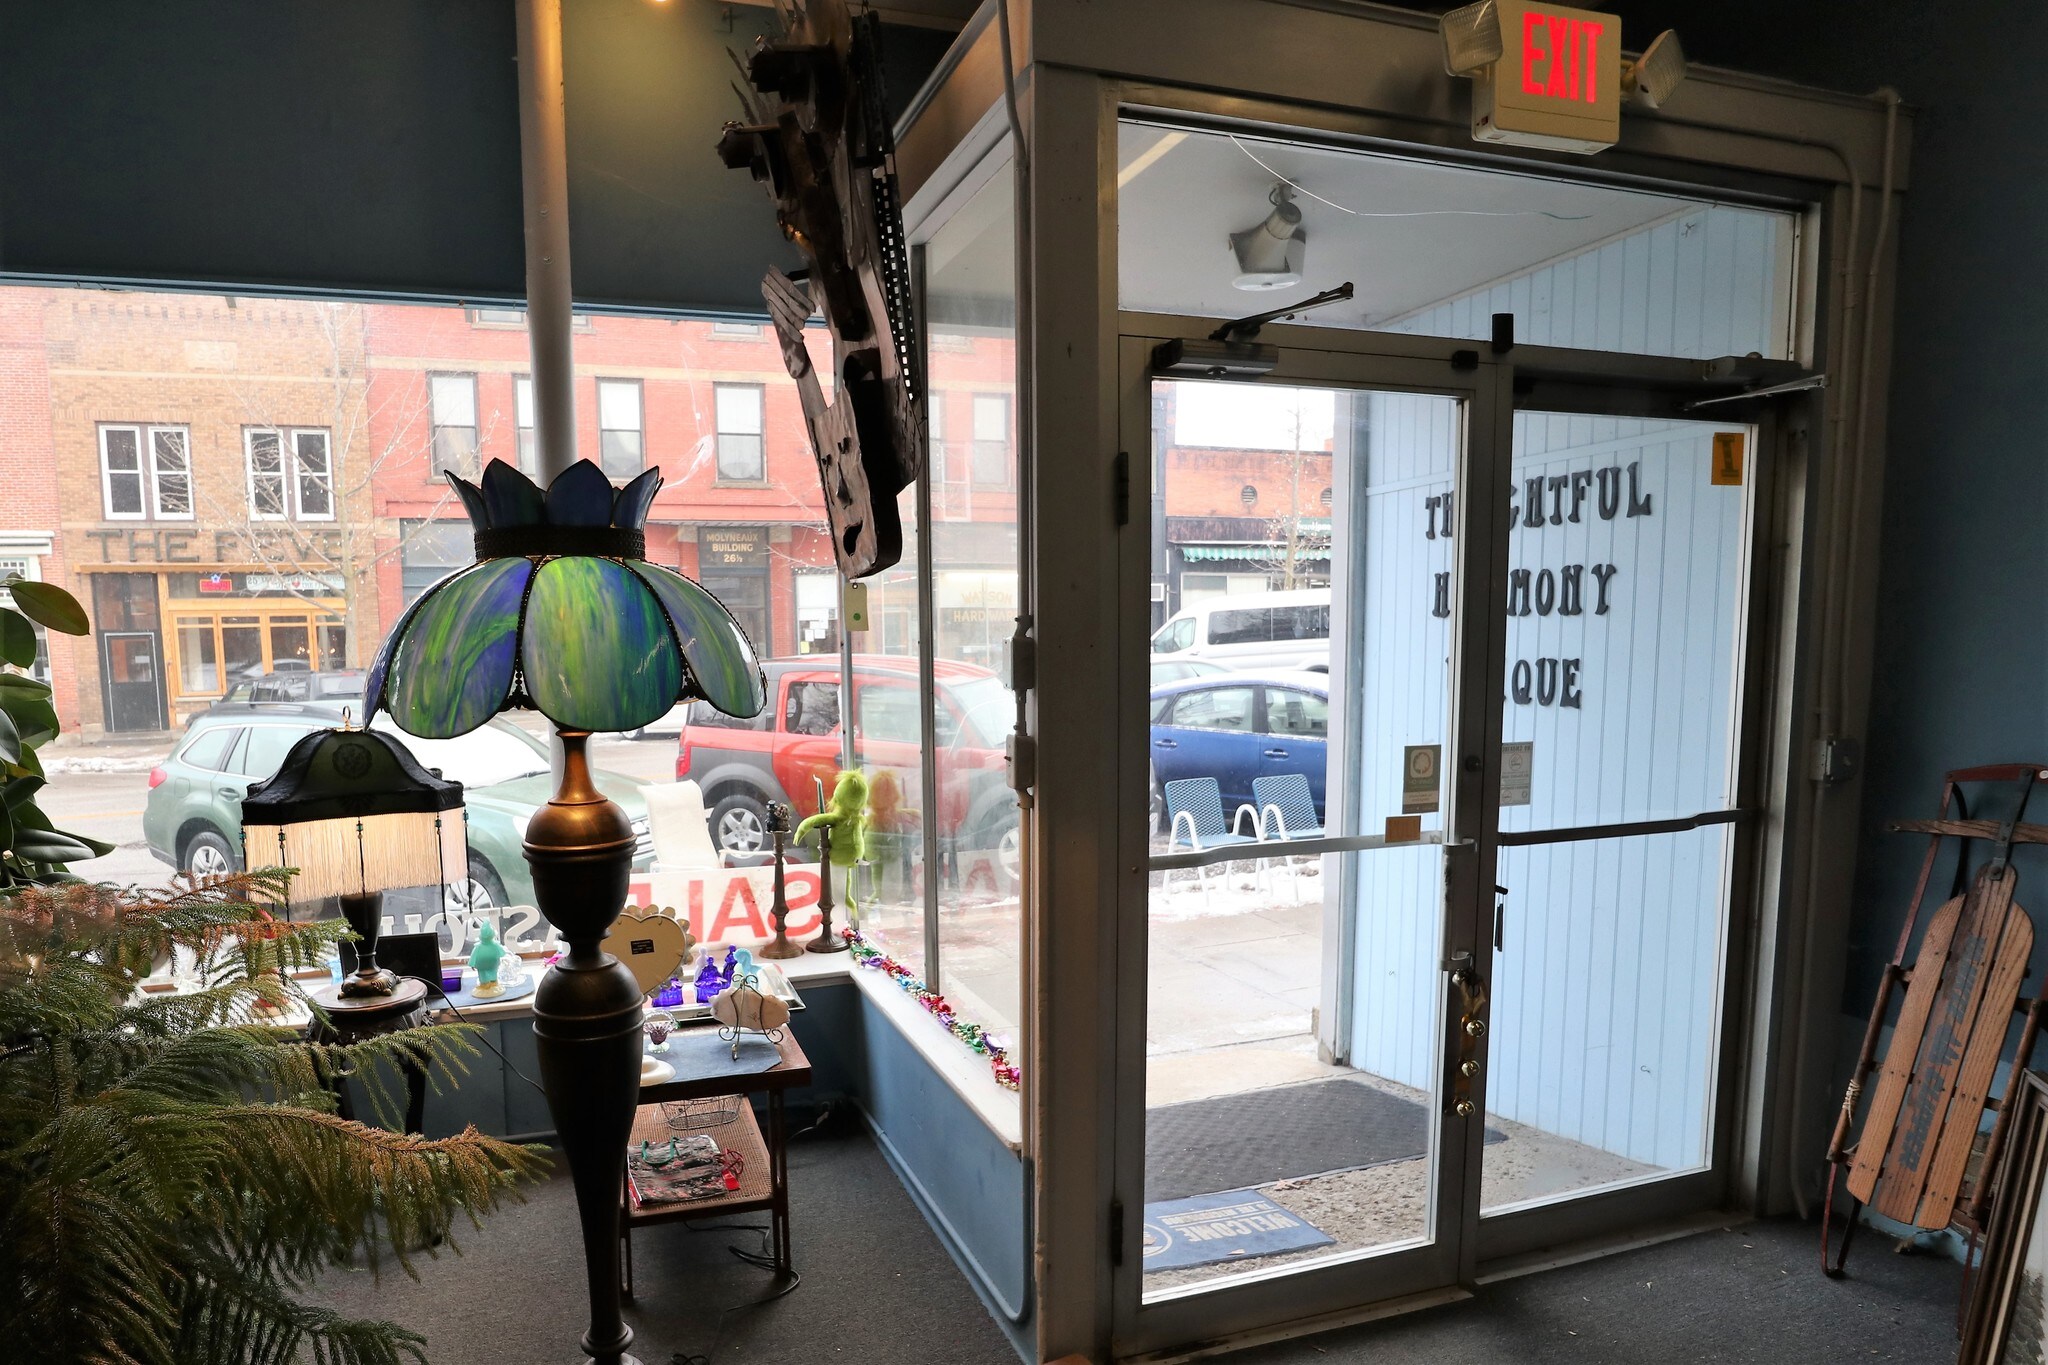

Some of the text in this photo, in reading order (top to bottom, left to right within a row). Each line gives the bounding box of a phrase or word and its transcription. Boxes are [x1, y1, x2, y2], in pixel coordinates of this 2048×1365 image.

[1522, 11, 1604, 104] EXIT
[1425, 461, 1651, 540] THHTFUL
[85, 530, 199, 562] THE
[706, 533, 759, 542] MOLYNEAUX
[712, 543, 754, 552] BUILDING
[1432, 563, 1617, 618] HMONY
[953, 610, 1018, 623] HARDWAR
[1176, 1214, 1299, 1241] WELCOME
